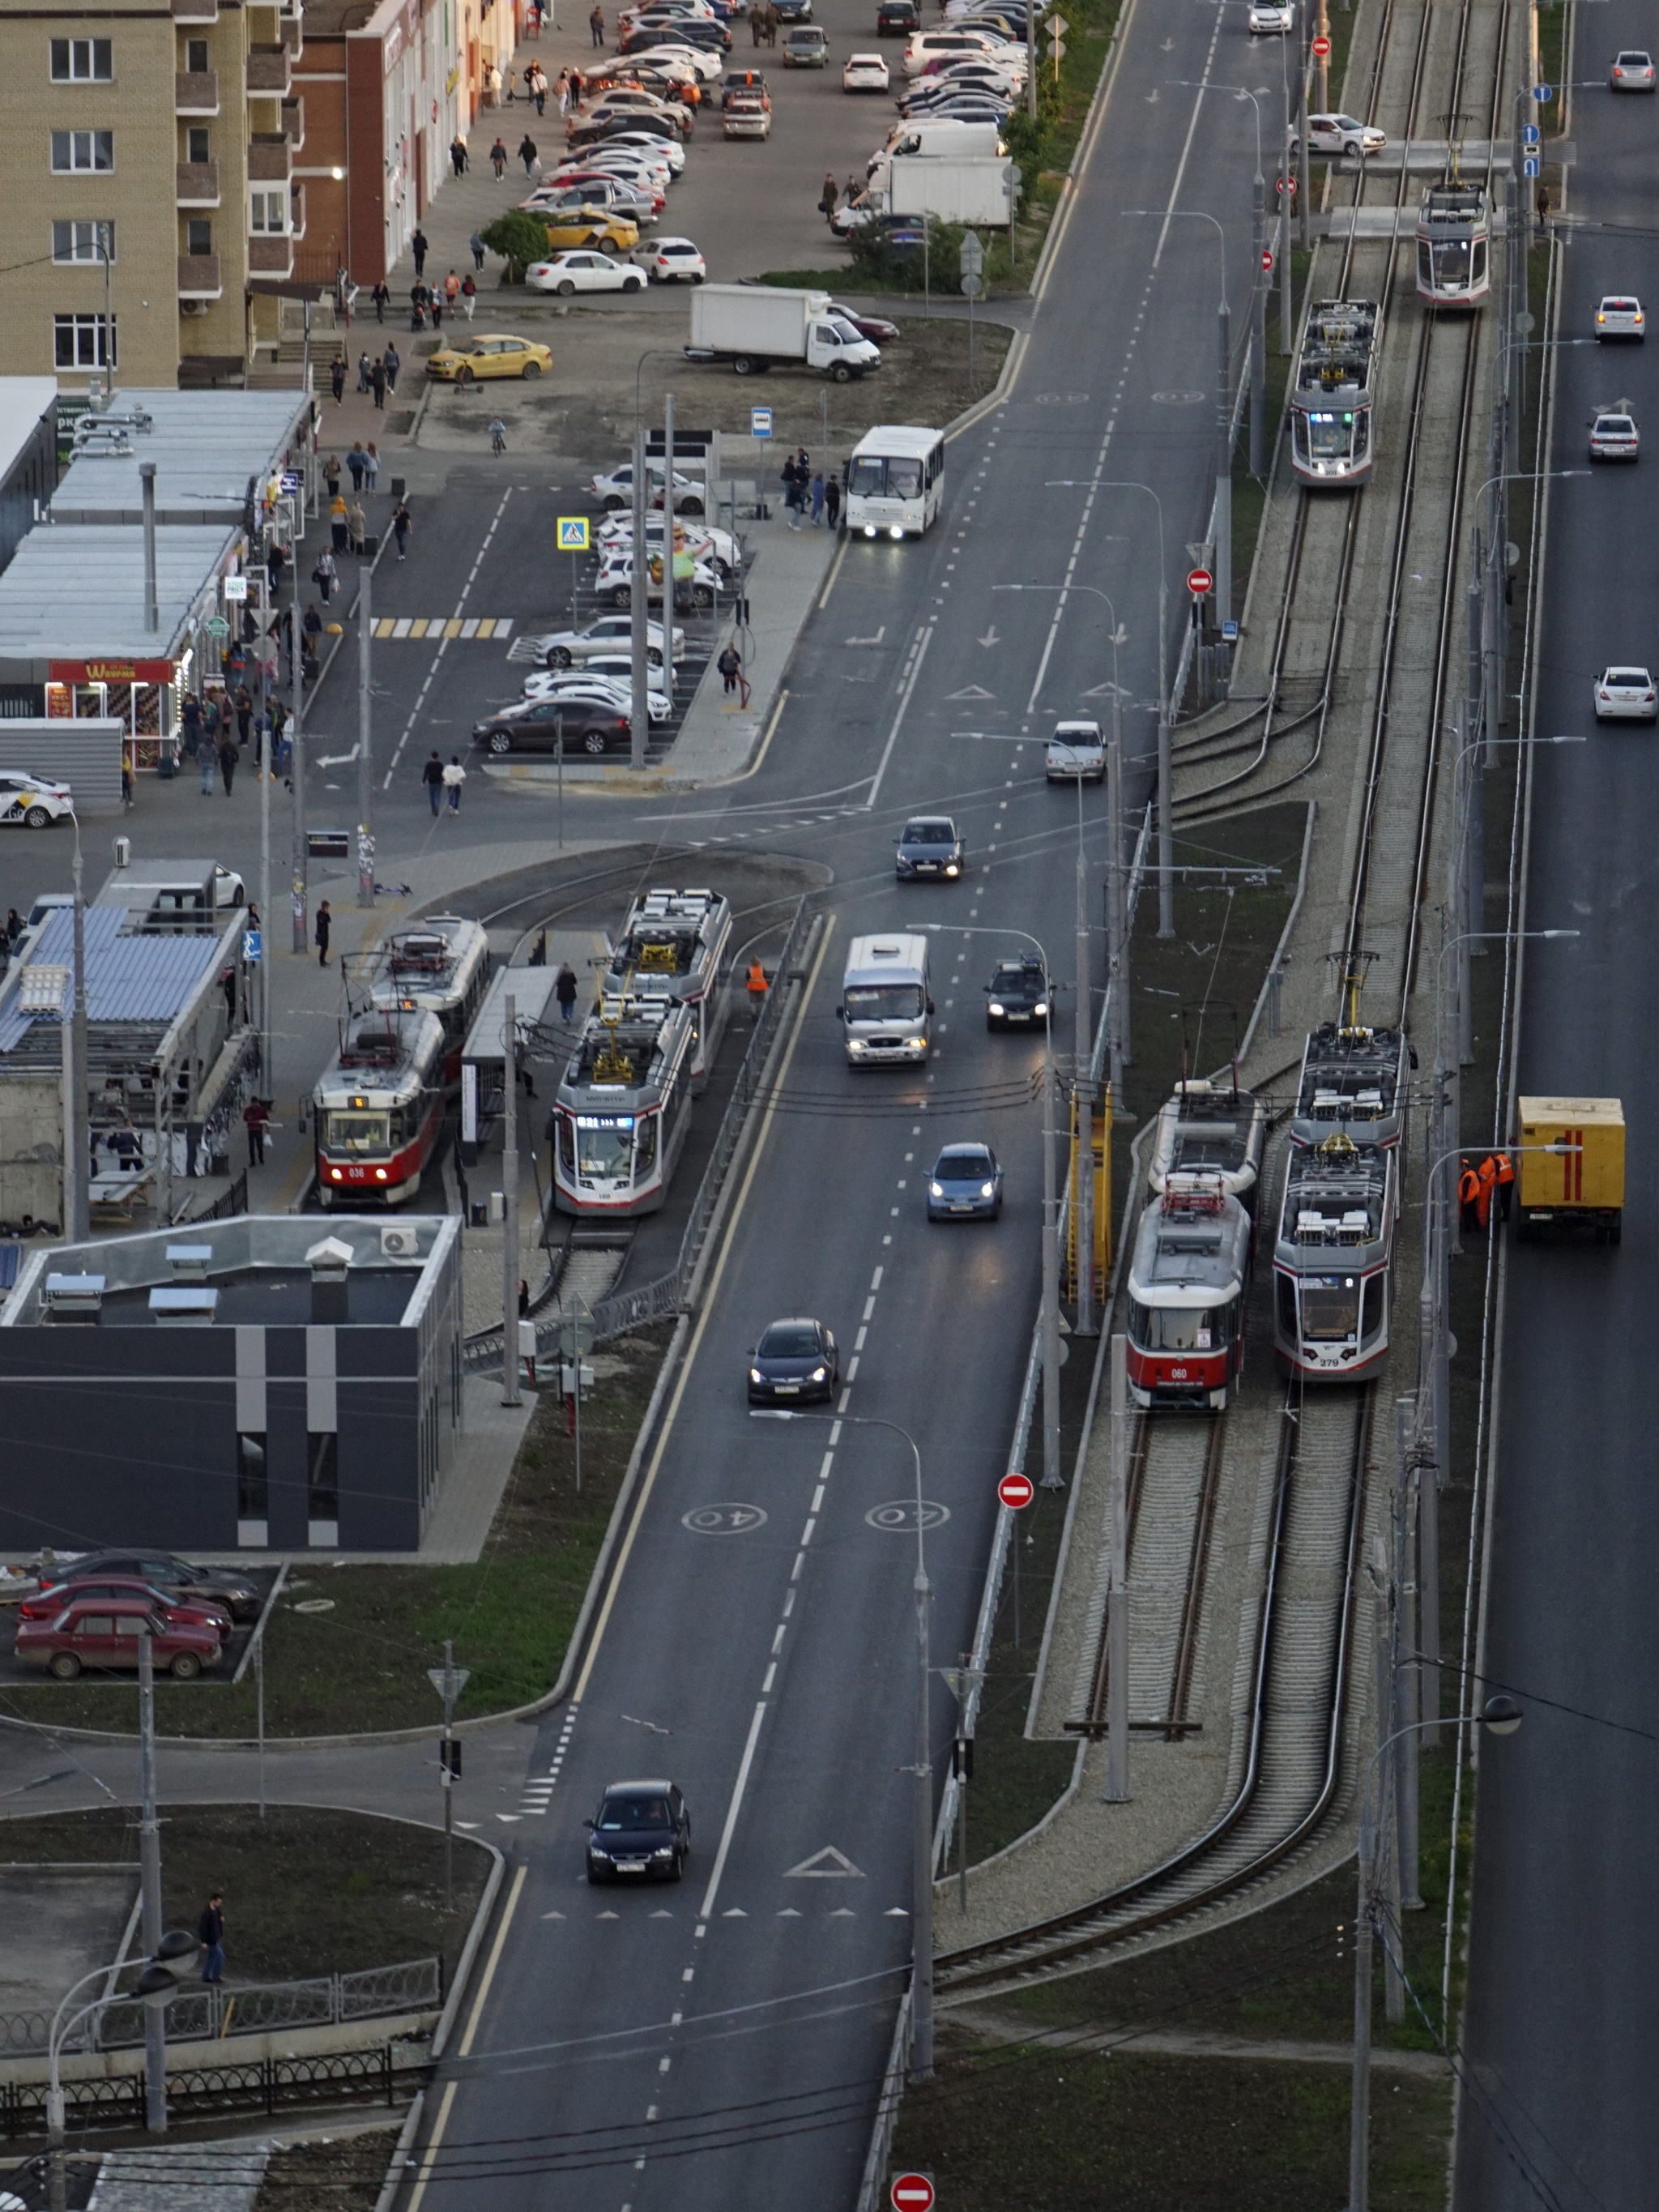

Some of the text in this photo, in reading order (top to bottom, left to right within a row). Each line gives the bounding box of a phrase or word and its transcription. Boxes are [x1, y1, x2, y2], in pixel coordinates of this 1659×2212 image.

[8, 807, 23, 819] Go
[349, 1167, 365, 1178] 036
[1320, 1359, 1339, 1367] 279
[1171, 1368, 1188, 1379] 060
[694, 1510, 757, 1527] 40
[877, 1507, 940, 1525] 40
